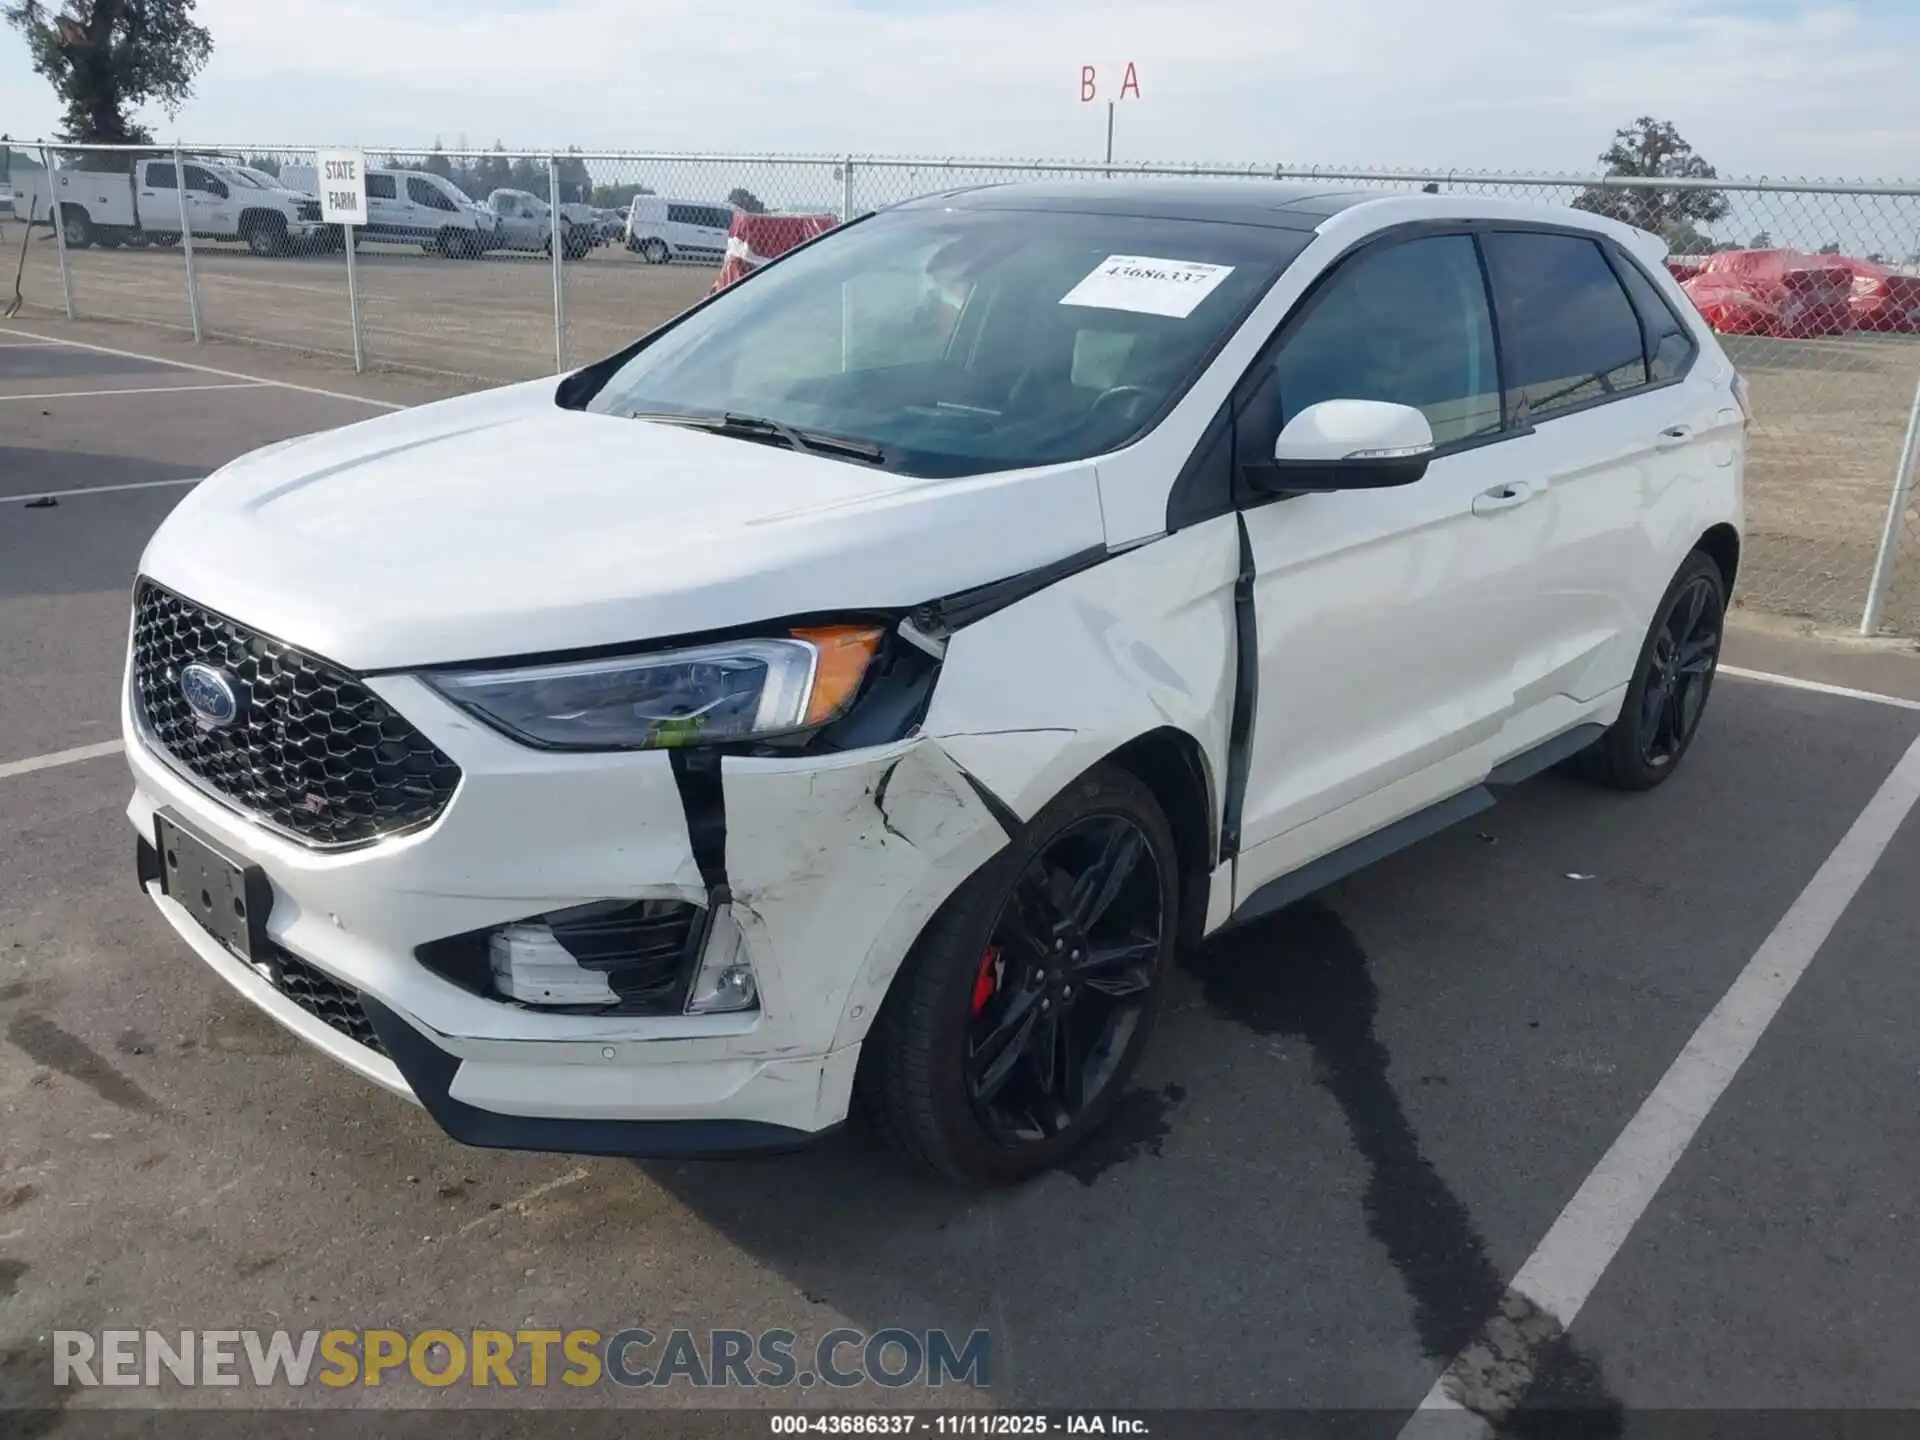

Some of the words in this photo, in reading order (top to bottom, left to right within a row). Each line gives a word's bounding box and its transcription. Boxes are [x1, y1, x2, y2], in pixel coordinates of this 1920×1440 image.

[1081, 65, 1096, 102] B
[1120, 61, 1140, 99] A
[325, 160, 355, 180] STATE
[328, 192, 357, 210] FARM
